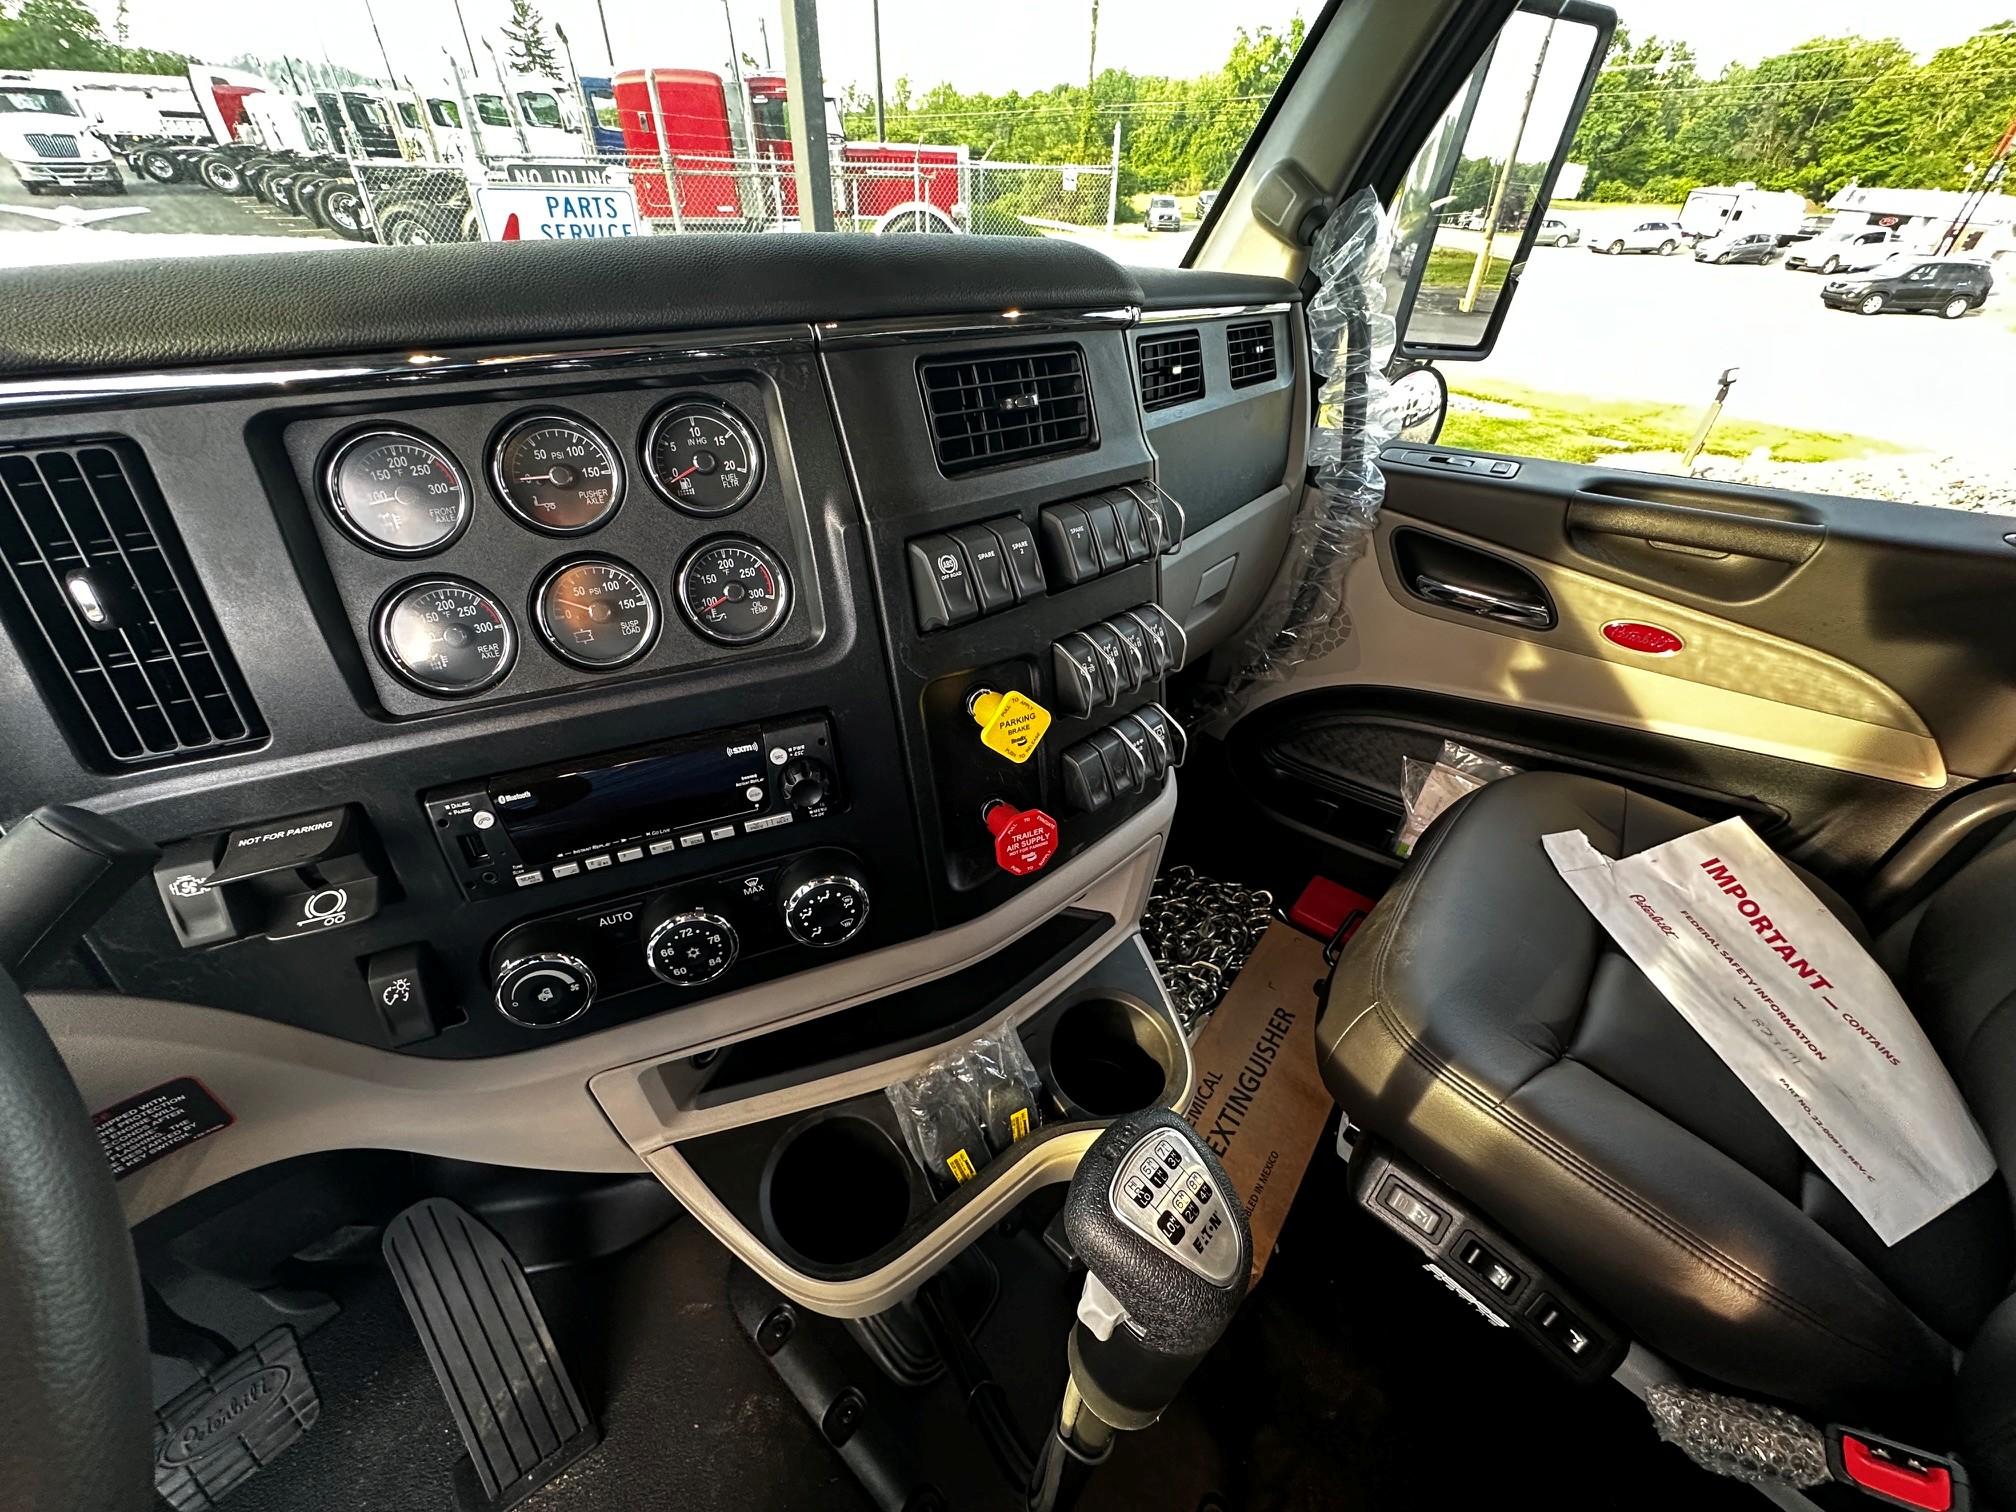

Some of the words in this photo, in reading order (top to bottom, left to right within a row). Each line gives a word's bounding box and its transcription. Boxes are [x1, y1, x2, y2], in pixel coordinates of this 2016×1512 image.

[514, 169, 543, 183] NO
[552, 169, 612, 184] IDLING
[546, 196, 618, 219] PARTS
[541, 224, 632, 240] SERVICE
[689, 426, 700, 437] 10
[670, 442, 676, 452] 5
[714, 436, 726, 446] 15
[534, 449, 546, 460] 50
[551, 452, 564, 460] PSI
[566, 446, 584, 457] 100
[387, 456, 408, 468] 200
[724, 460, 736, 471] 20
[370, 469, 390, 481] 150
[410, 464, 431, 476] 250
[582, 466, 600, 478] 150
[672, 468, 678, 478] 0
[428, 482, 448, 495] 300
[578, 488, 608, 499] PUSHER
[586, 496, 605, 504] AXLE
[430, 506, 456, 516] FRONT
[1012, 540, 1028, 550] SPARE
[978, 550, 996, 560] SPARE
[718, 558, 734, 570] 200
[942, 559, 954, 568] ABS
[740, 567, 756, 578] 250
[700, 574, 717, 584] 150
[573, 586, 586, 597] 50
[589, 588, 602, 596] PSI
[602, 580, 620, 592] 100
[748, 588, 764, 600] 300
[436, 600, 455, 612] 200
[618, 598, 636, 610] 150
[457, 605, 477, 618] 250
[565, 609, 572, 620] 0
[750, 606, 768, 615] TEMP
[474, 622, 493, 634] 300
[620, 620, 639, 630] SUSP
[622, 626, 640, 636] LOAD
[478, 642, 500, 654] REAR
[481, 650, 500, 660] AXLE
[1000, 712, 1036, 730] PARKING
[1008, 724, 1030, 736] BRAKE
[238, 836, 262, 847] NOT
[262, 831, 285, 842] FOR
[286, 820, 333, 836] PARKING
[1012, 828, 1044, 842] TRAILER
[1006, 842, 1020, 852] AIR
[1020, 832, 1050, 848] SUPPLY
[744, 884, 764, 896] MAX
[599, 912, 634, 927] AUTO
[1629, 894, 1680, 940] Peterbilt
[680, 928, 694, 938] 72
[707, 934, 721, 945] 78
[660, 949, 674, 958] 66
[708, 956, 722, 966] 84
[1700, 858, 1834, 990] IMPORTANT
[1842, 1013, 1900, 1066] CONTAINS
[673, 967, 688, 976] 60
[1680, 910, 1720, 951] FEDERAL
[1720, 950, 1758, 986] SAFETY
[1754, 987, 1827, 1062] INFORMATION
[1206, 1007, 1297, 1159] EXTINGUISHER
[138, 1095, 167, 1110] WITH
[1778, 1078, 1800, 1098] PART
[1798, 1098, 1812, 1115] NO.
[118, 1094, 186, 1127] PROTECTION
[110, 1116, 151, 1140] ENGINE
[152, 1106, 178, 1119] WILL
[152, 1108, 185, 1126] AFTER
[168, 1120, 190, 1130] THE
[120, 1130, 182, 1162] RESTARTED
[182, 1121, 197, 1132] BY
[126, 1152, 146, 1167] KEY
[1168, 1158, 1176, 1167] 3
[1142, 1165, 1152, 1174] 5
[1258, 1151, 1280, 1184] MEXICO
[1188, 1181, 1198, 1191] 8
[1255, 1182, 1264, 1194] IN
[1198, 1190, 1208, 1200] 4
[1176, 1199, 1184, 1209] 6
[1185, 1211, 1194, 1222] 2
[1162, 1223, 1176, 1238] LO
